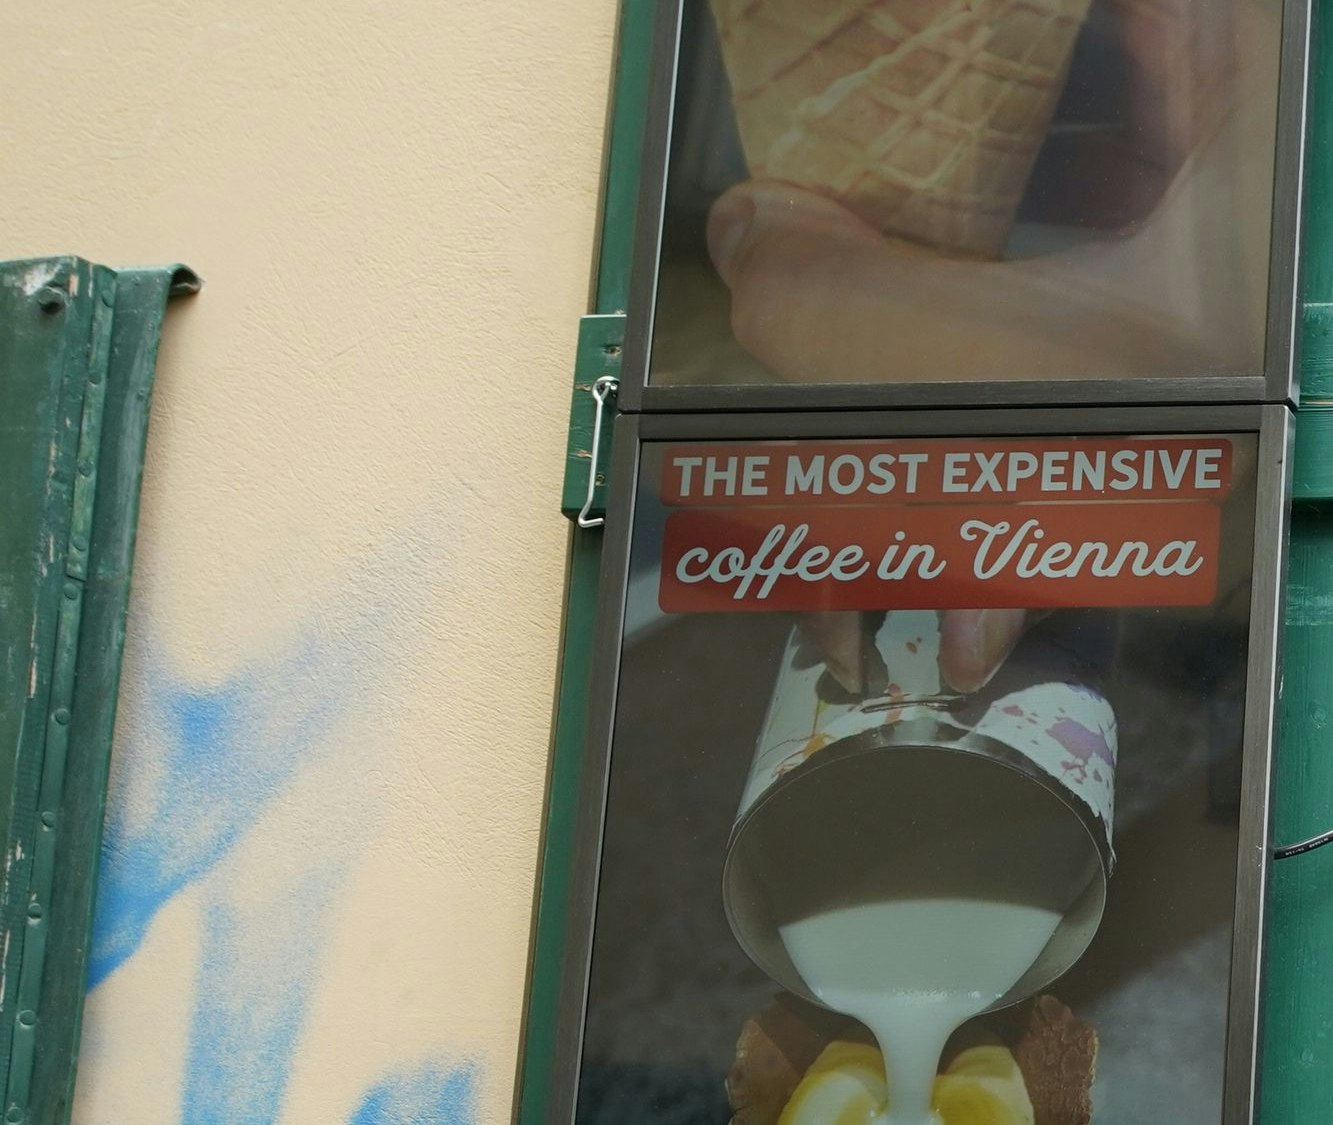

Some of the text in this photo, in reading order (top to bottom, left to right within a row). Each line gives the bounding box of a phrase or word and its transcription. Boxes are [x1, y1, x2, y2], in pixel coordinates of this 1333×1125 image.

[672, 448, 1223, 498] THE MOST EXPENSIVE
[675, 519, 1203, 599] coffee in Vienna
